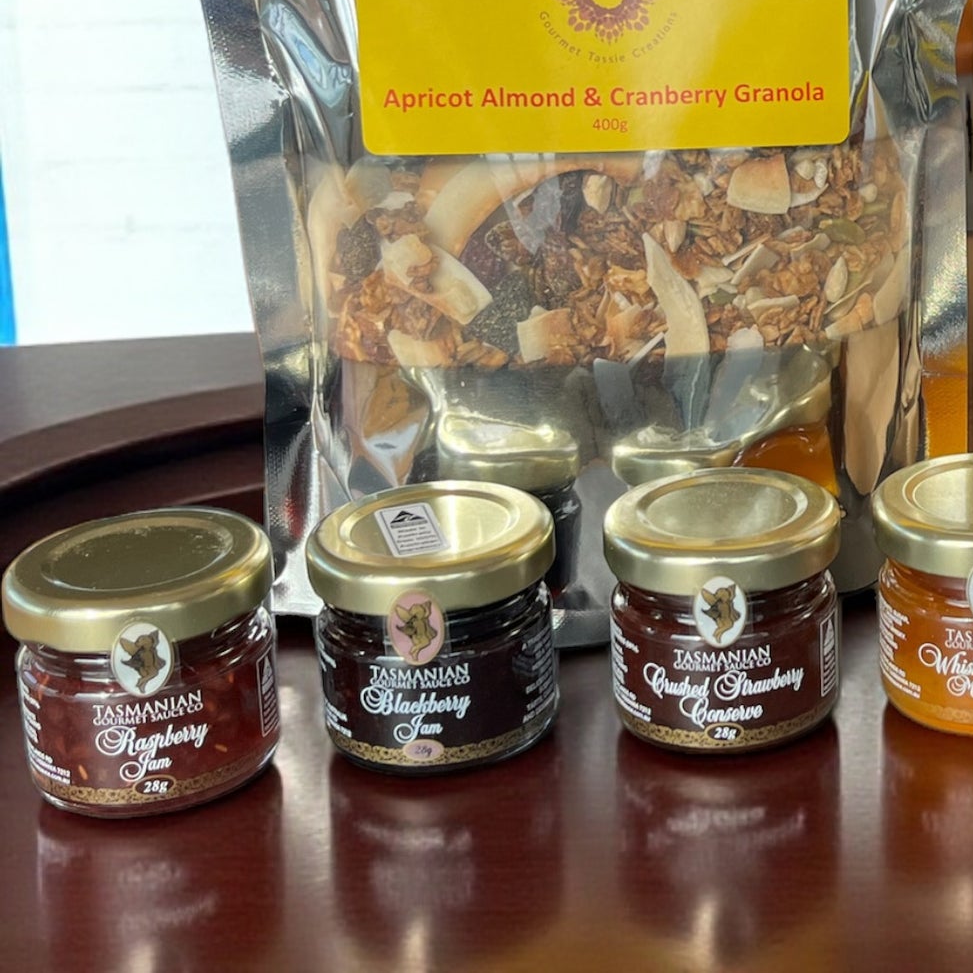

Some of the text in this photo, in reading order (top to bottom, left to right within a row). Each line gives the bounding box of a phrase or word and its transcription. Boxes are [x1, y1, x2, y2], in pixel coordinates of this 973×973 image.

[540, 11, 678, 64] Gourmet Tassie Creations
[384, 82, 825, 111] Apricot Almond & Cranberry Granola
[592, 117, 629, 132] 400g
[673, 644, 771, 664] TASMANIAN
[673, 657, 772, 672] GOURMET SAUCE CO
[369, 663, 469, 680] TASMANIAN
[370, 675, 471, 689] GOURMET SAUCE CO
[643, 662, 710, 699] Crushed
[713, 666, 804, 701] Strawberry
[93, 690, 202, 718] TASMANIAN
[93, 702, 204, 726] GOURMET SAUCE CO
[360, 683, 471, 719] Blackberry
[679, 695, 763, 729] Conserve
[95, 722, 208, 755] Raspberry
[393, 713, 443, 744] Jam
[713, 727, 737, 740] 28g
[414, 745, 433, 756] 28g
[119, 751, 172, 782] Jam
[143, 780, 169, 794] 28g
